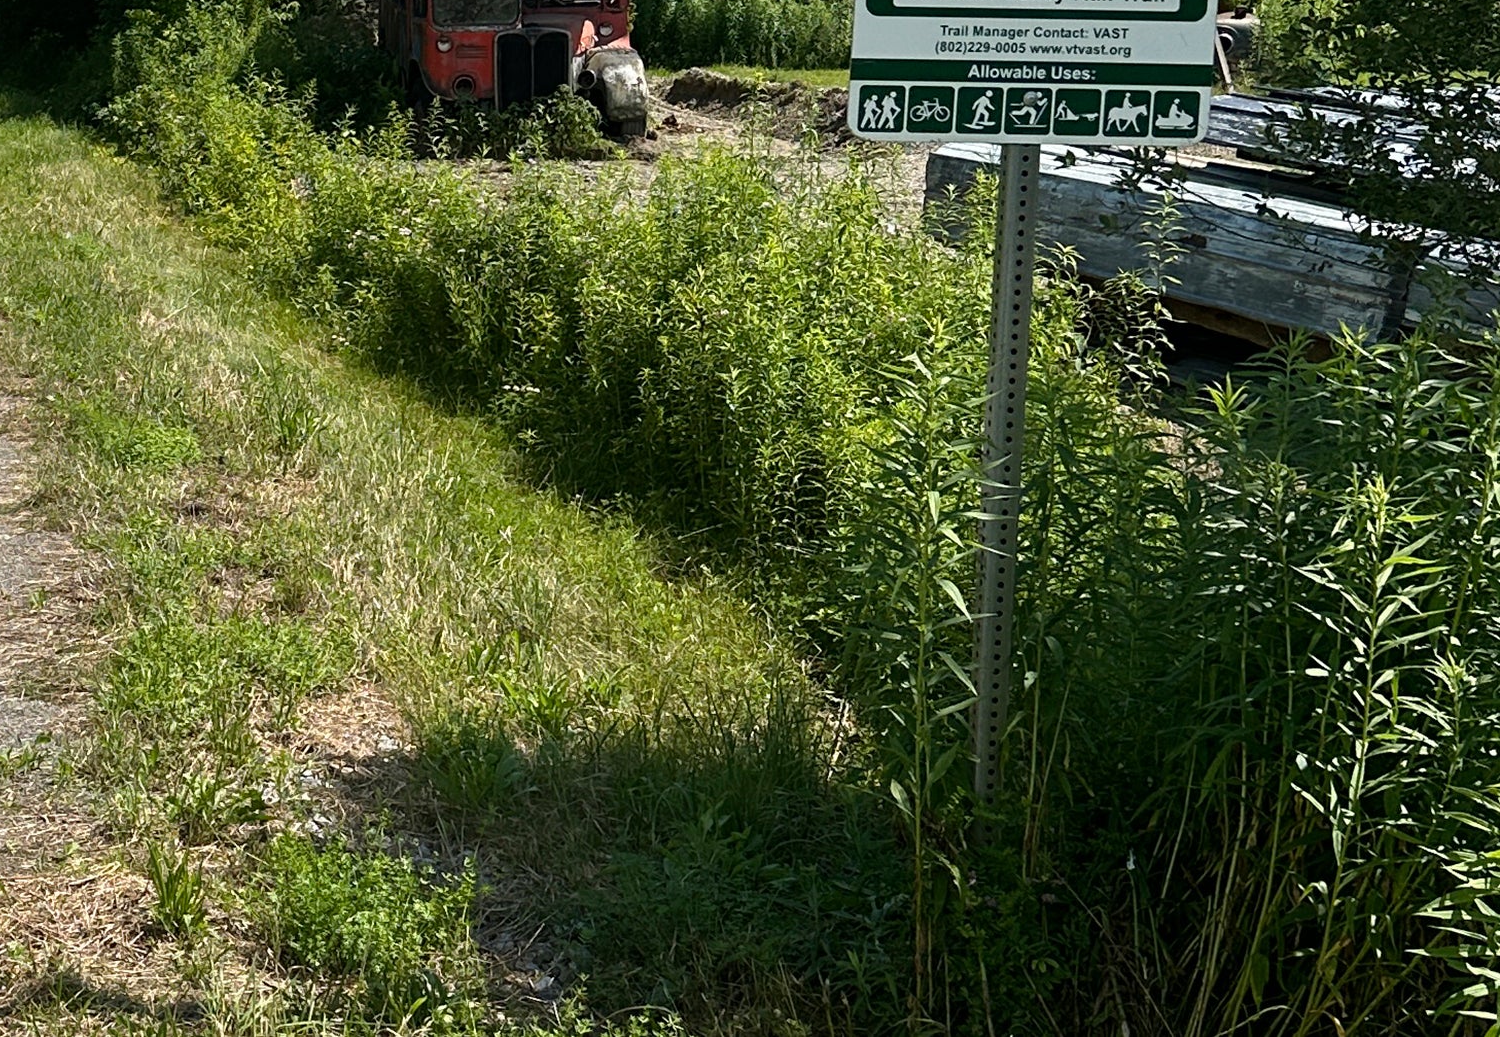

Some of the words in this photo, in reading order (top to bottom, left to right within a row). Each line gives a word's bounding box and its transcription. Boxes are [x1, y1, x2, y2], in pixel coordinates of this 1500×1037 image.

[939, 24, 968, 36] Trail
[972, 25, 1030, 40] Manager
[1033, 26, 1088, 38] Contact:
[1093, 27, 1129, 39] VAST
[934, 41, 1026, 55] (802)229-0005
[1029, 44, 1132, 58] www.vtvast.org
[967, 64, 1046, 79] Allowable
[1050, 65, 1096, 80] Uses:
